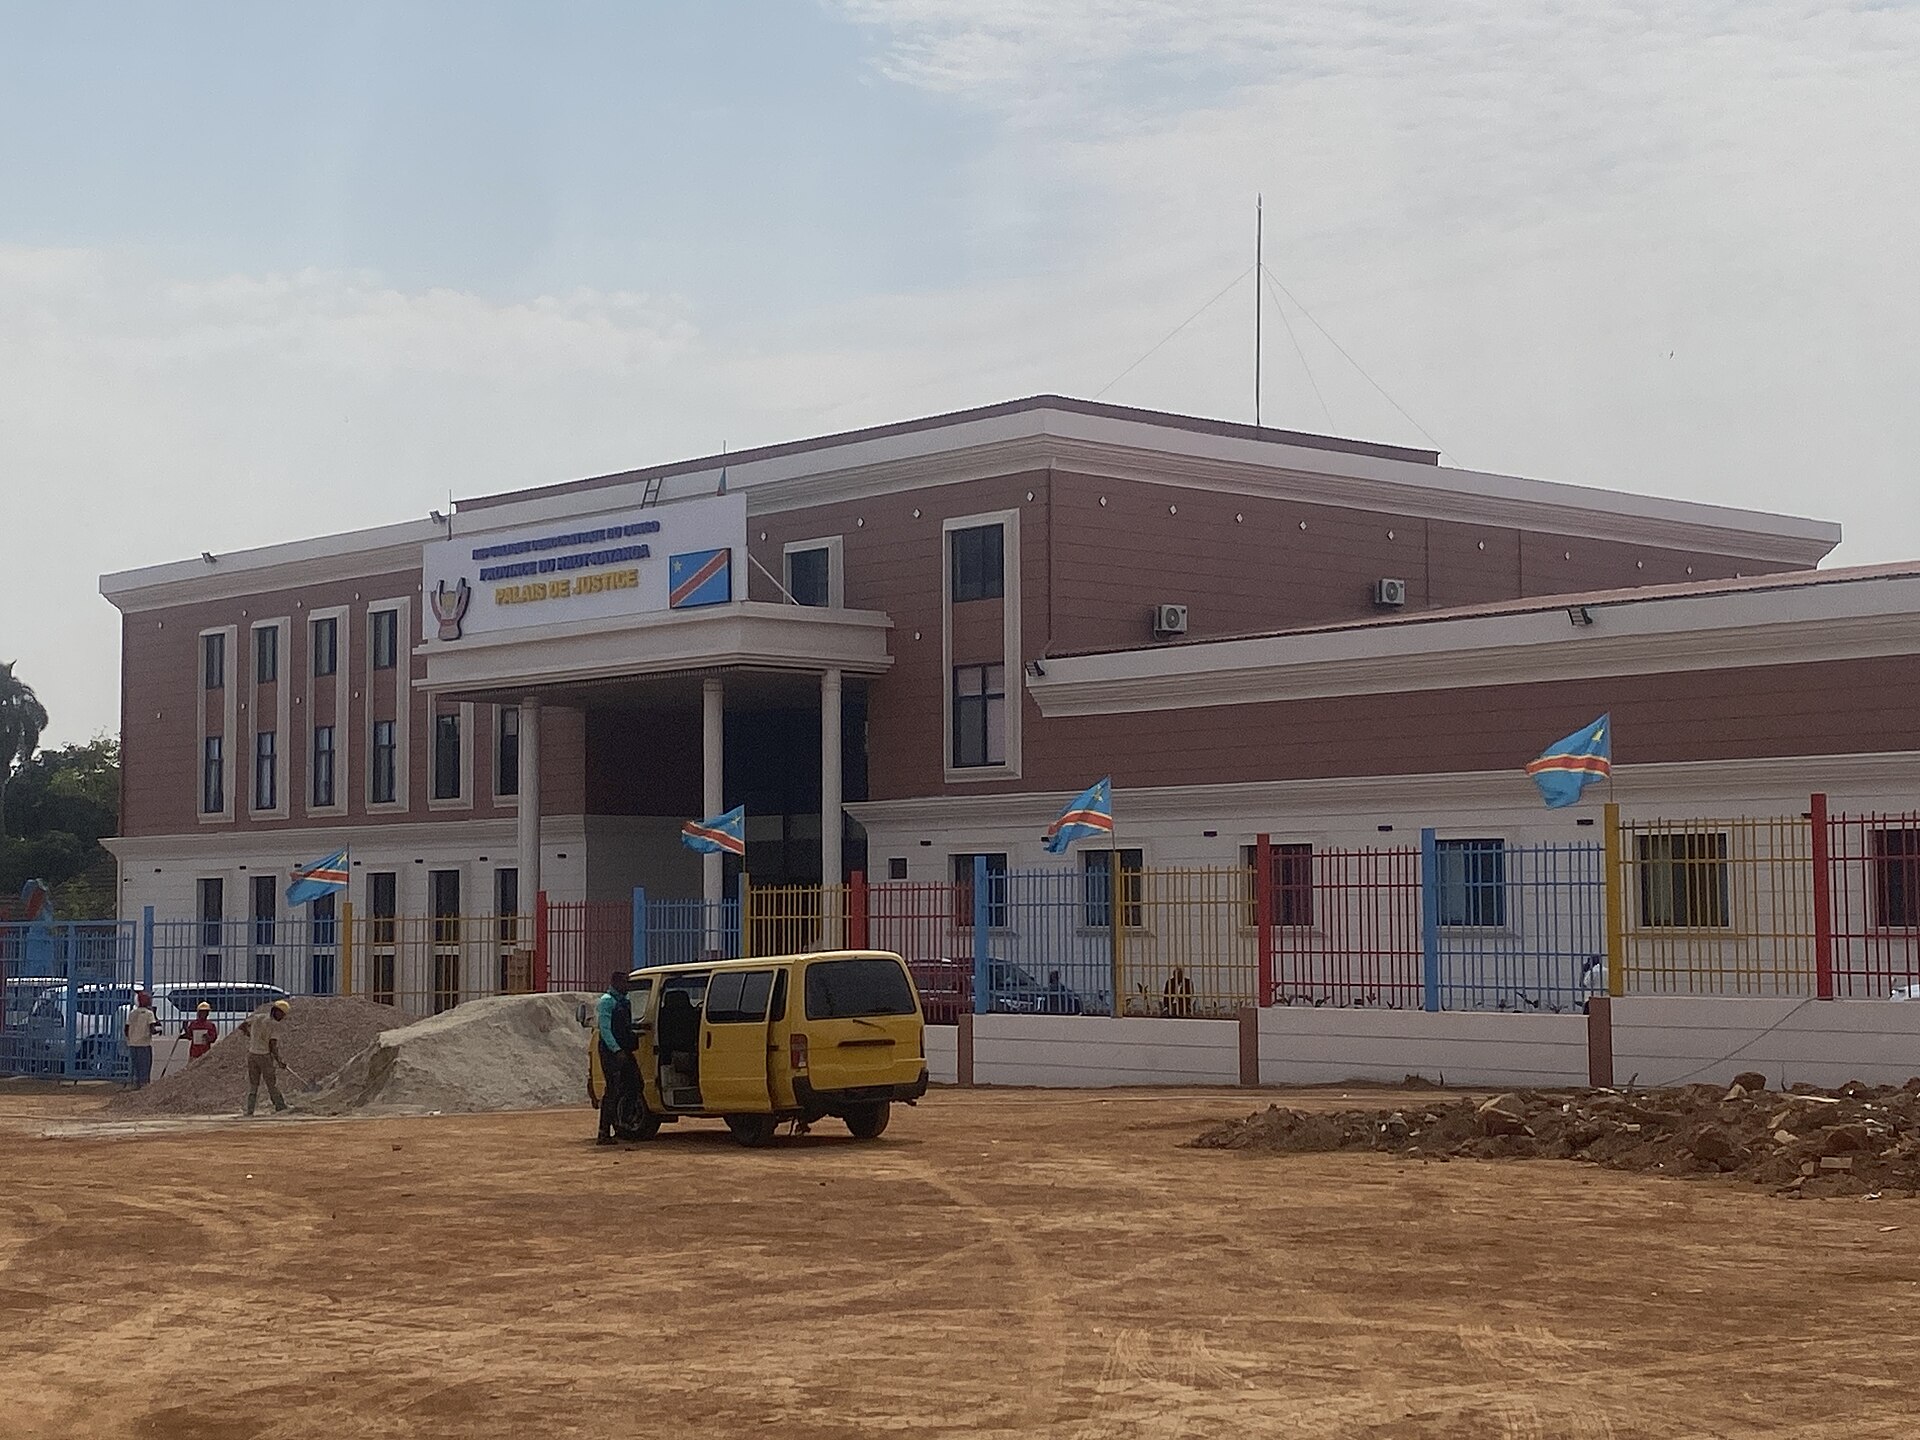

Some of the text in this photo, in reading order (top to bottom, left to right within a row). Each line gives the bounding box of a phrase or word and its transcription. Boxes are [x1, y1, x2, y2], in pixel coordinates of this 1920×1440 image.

[539, 558, 556, 573] DU
[495, 569, 639, 605] PALAIS DE JUSTICE
